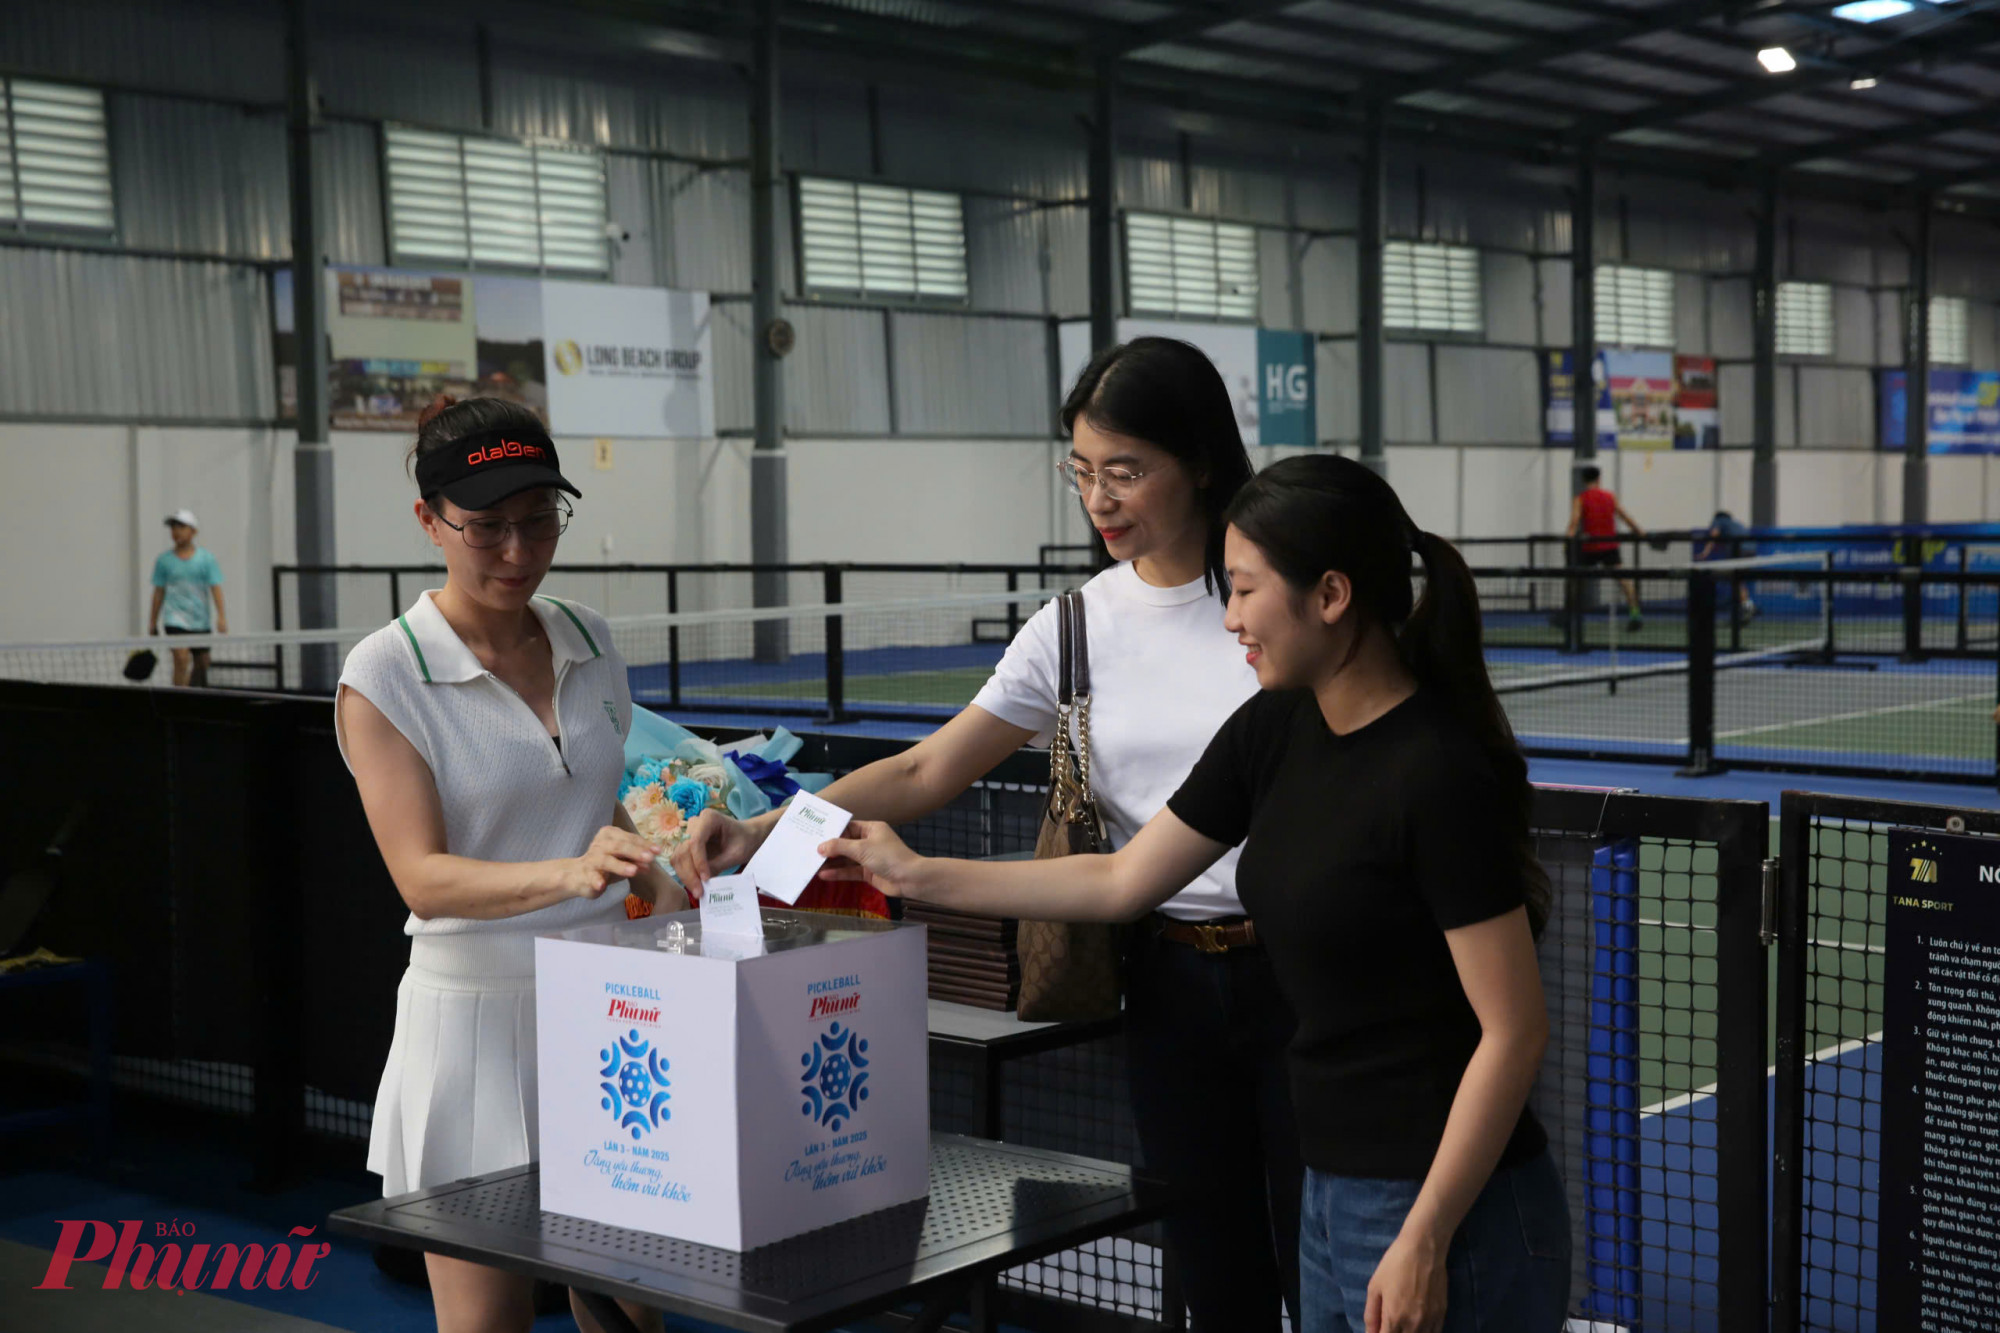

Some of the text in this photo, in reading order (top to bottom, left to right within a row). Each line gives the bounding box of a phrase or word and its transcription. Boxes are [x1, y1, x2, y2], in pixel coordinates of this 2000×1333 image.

[586, 346, 702, 370] LONG BEACH GROUP
[1266, 363, 1308, 401] HG
[1893, 896, 1954, 912] TANA SPORT
[606, 982, 661, 1000] PICKLEBALL
[808, 974, 861, 995] PICKLEBALL
[1928, 998, 1947, 1009] xung
[1948, 1001, 1974, 1012] quanh.
[1952, 1033, 1967, 1042] sinh
[1926, 1042, 1950, 1056] Không
[1982, 1081, 1997, 1092] quy
[1943, 1091, 1963, 1104] trang
[1925, 1102, 1943, 1112] thao.
[1946, 1106, 1966, 1119] Mang
[850, 1130, 868, 1144] 2025
[1925, 1131, 1946, 1143] mang
[1968, 1139, 1982, 1148] cao
[651, 1150, 670, 1162] 2025
[1924, 1143, 1948, 1157] Không
[1980, 1153, 1994, 1166] hay
[1924, 1157, 1935, 1166] khi
[1938, 1160, 1957, 1172] tham
[1959, 1165, 1971, 1174] gia
[642, 1184, 660, 1197] vui
[1959, 1211, 1975, 1220] gian
[1923, 1218, 1936, 1228] quy
[1938, 1283, 1950, 1292] cho
[1976, 1278, 1992, 1288] gian
[1922, 1294, 1938, 1304] gian
